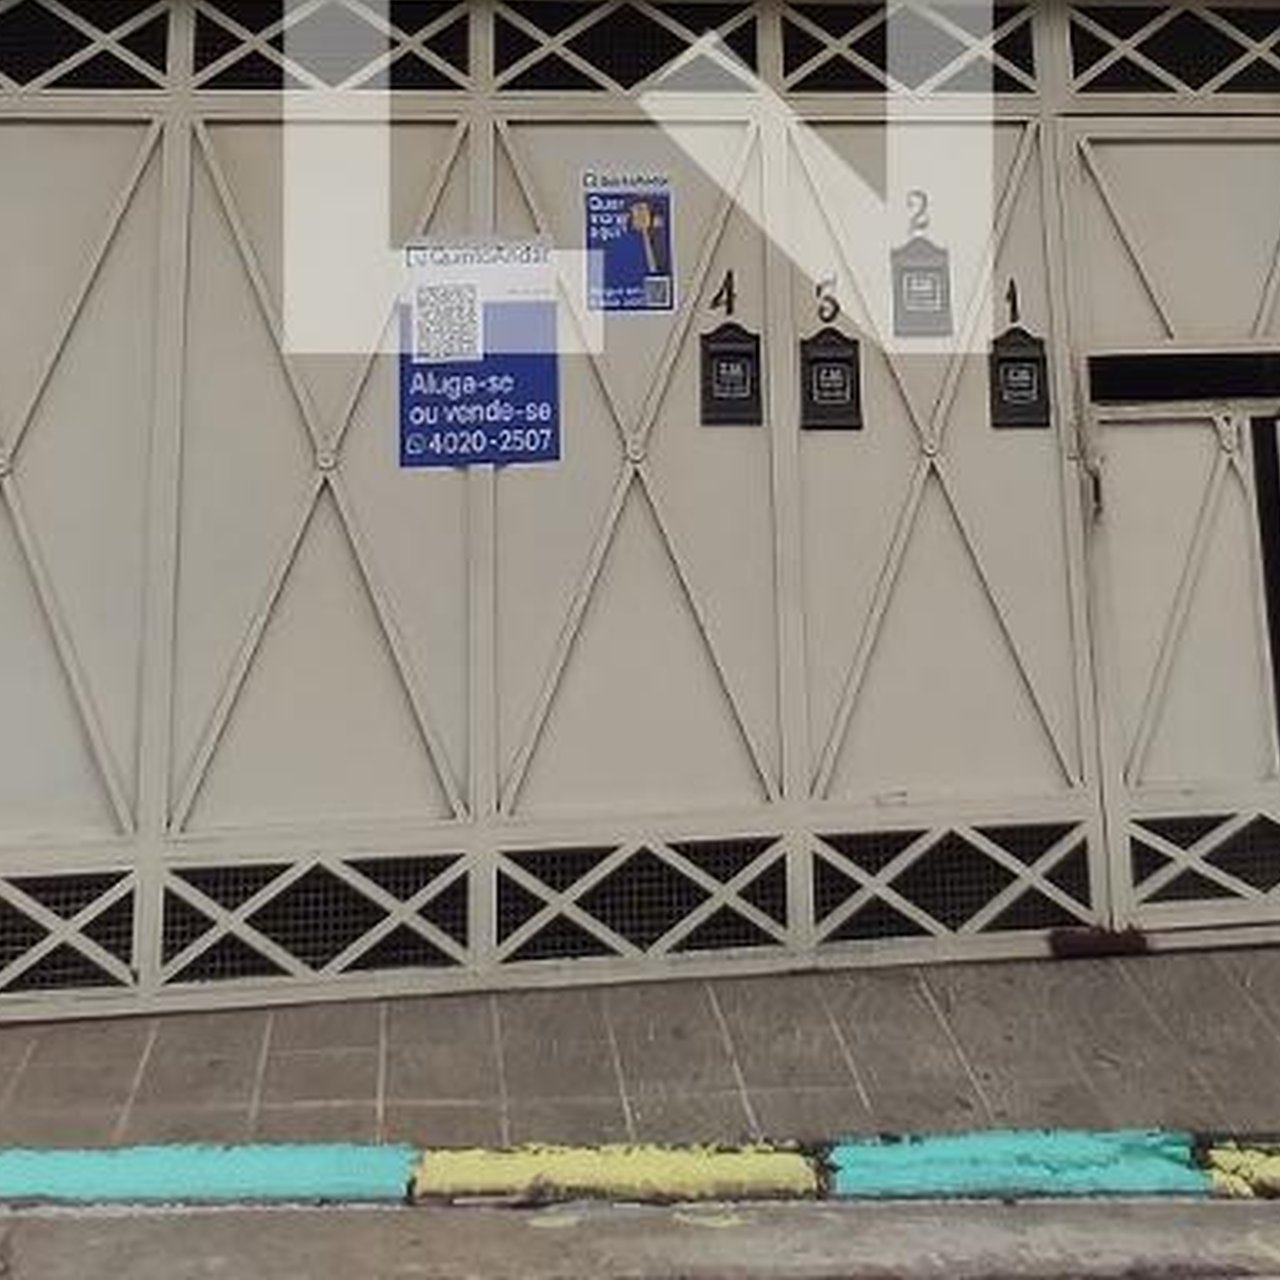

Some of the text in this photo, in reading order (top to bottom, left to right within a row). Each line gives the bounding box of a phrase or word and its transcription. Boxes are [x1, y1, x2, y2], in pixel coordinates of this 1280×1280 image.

[906, 190, 930, 235] 2
[709, 270, 736, 315] 4
[1006, 278, 1019, 323] 1
[410, 372, 514, 400] Aluga-se
[409, 399, 552, 424] ou vende-se
[429, 428, 552, 454] 4020-2507
